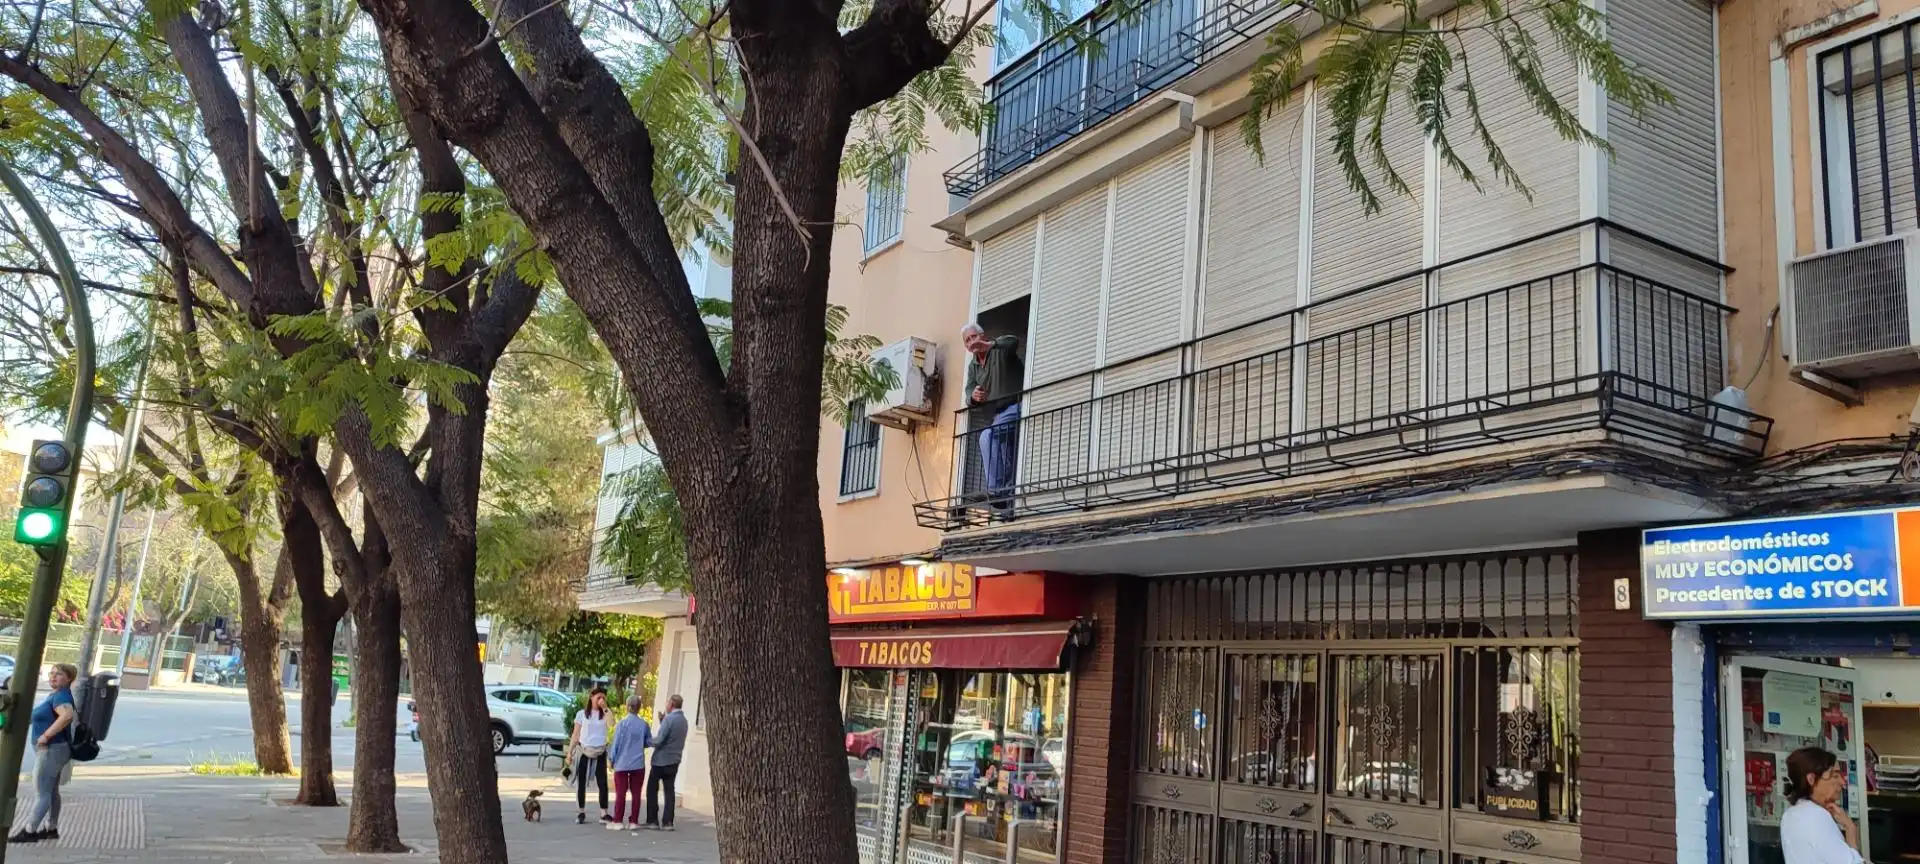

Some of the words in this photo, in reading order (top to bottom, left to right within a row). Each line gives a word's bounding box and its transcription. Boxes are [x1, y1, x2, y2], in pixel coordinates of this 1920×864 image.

[1653, 531, 1830, 556] Electrodomésticos
[1655, 562, 1699, 579] MUY
[1703, 553, 1854, 578] ECONÓMICOS
[857, 563, 973, 604] TABACOS
[1616, 585, 1627, 602] 8
[1656, 585, 1773, 603] Procedentes
[1778, 582, 1806, 599] de
[1811, 578, 1888, 598] STOCK
[859, 641, 932, 665] TABACOS
[1486, 795, 1538, 811] PUBLICIDAD
